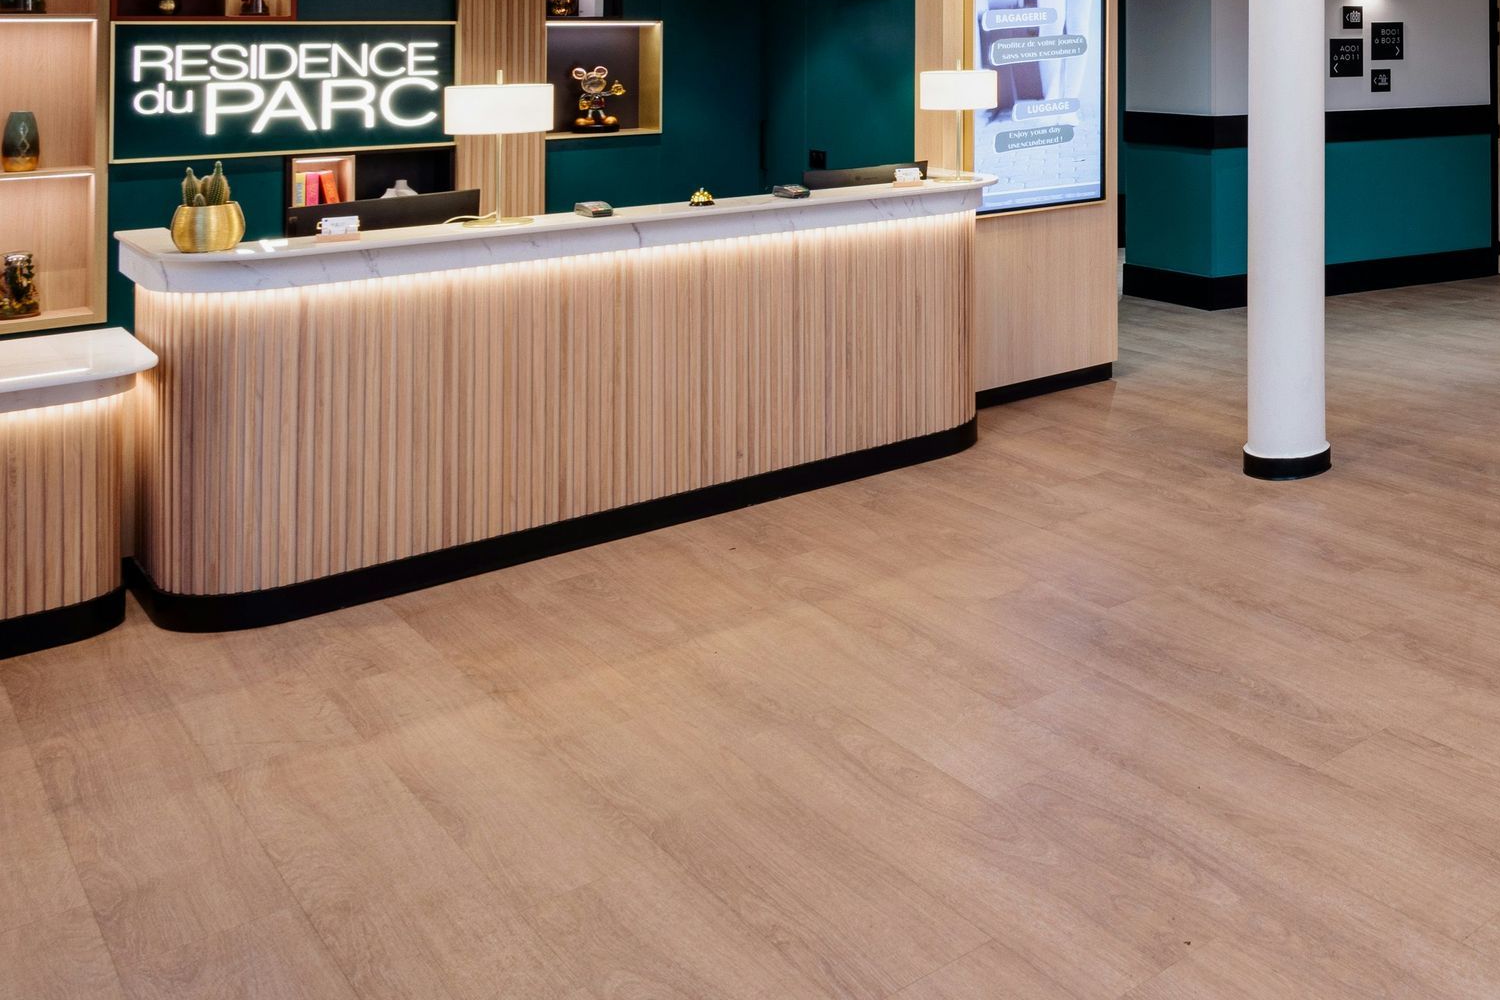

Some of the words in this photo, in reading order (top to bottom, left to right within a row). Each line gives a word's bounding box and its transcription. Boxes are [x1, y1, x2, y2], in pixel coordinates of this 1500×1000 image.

[995, 11, 1048, 24] BAGAGERIE
[132, 41, 439, 82] RESIDENCE
[132, 82, 194, 115] du
[204, 77, 439, 136] PARC
[1027, 101, 1070, 114] LUGGAGE
